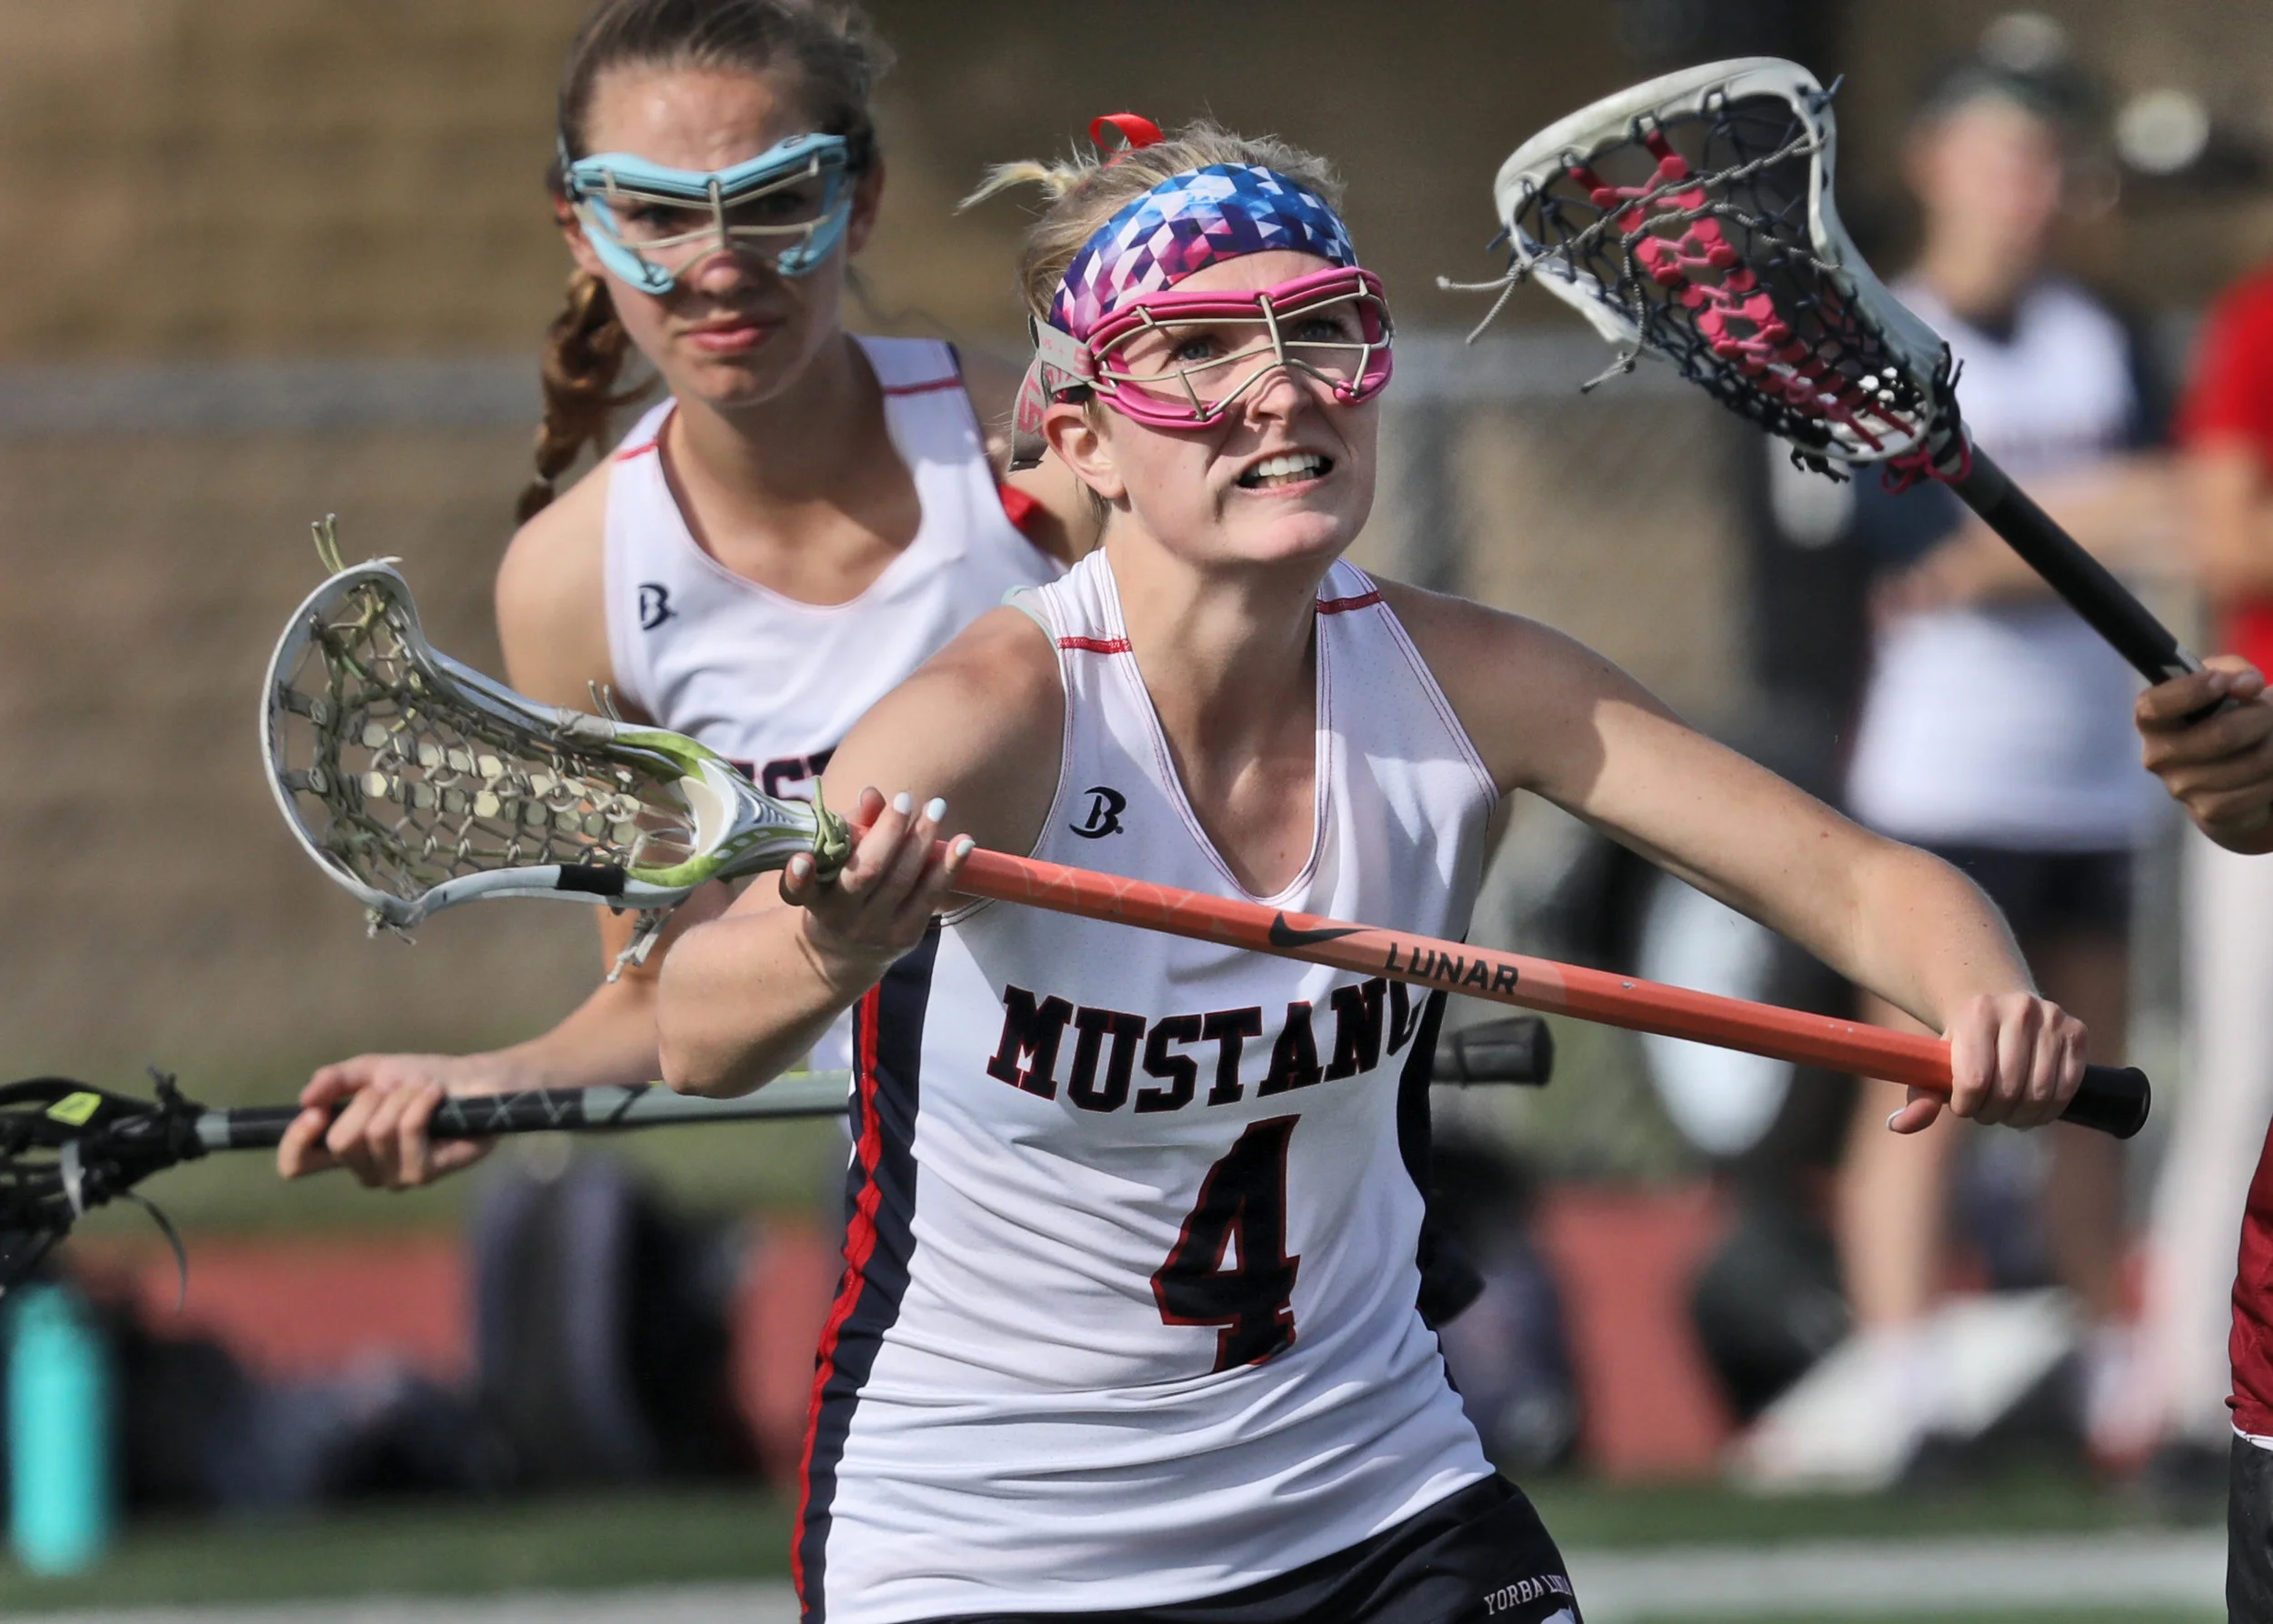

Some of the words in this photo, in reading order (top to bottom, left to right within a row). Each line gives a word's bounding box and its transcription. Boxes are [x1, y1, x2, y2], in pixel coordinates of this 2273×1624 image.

[1384, 942, 1519, 996] LUNAR
[1149, 1114, 1301, 1373] 4
[1484, 1577, 1545, 1616] YORBA
